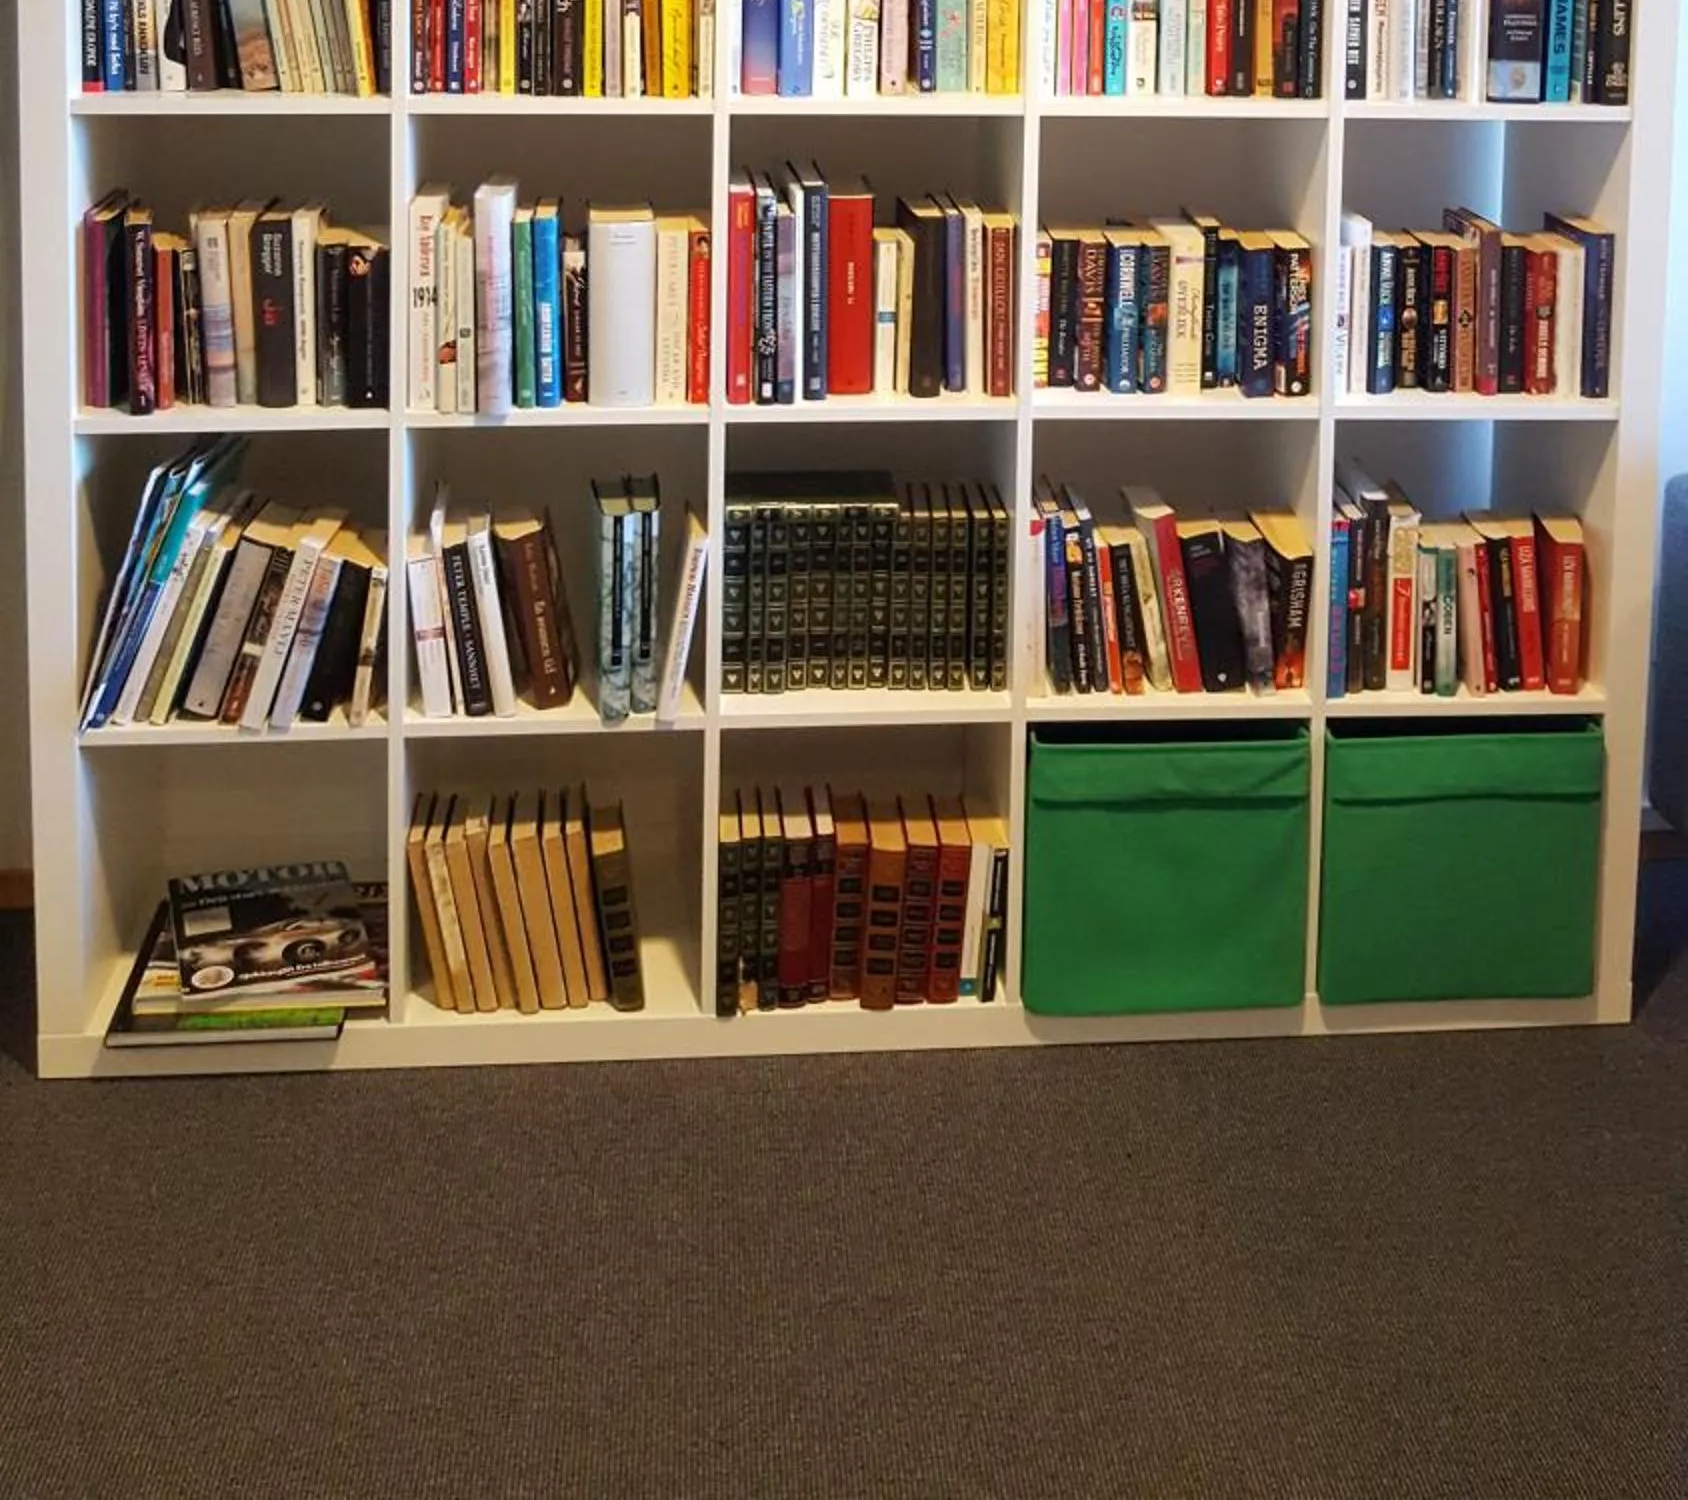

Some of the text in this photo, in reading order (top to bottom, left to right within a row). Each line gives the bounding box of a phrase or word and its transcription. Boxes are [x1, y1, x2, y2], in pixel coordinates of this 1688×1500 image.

[273, 232, 283, 277] Suzanne
[1086, 248, 1098, 295] DAVIS
[1119, 253, 1135, 309] CORNWELL
[1288, 252, 1299, 316] PATTERSON
[1120, 326, 1131, 374] PREDATOR
[1253, 304, 1269, 372] ENIGMA
[451, 555, 465, 587] PETER
[455, 589, 472, 630] TEMPLE
[1287, 571, 1306, 629] GRISHAM
[1443, 595, 1454, 635] COBEN
[178, 861, 345, 894] MOTOR
